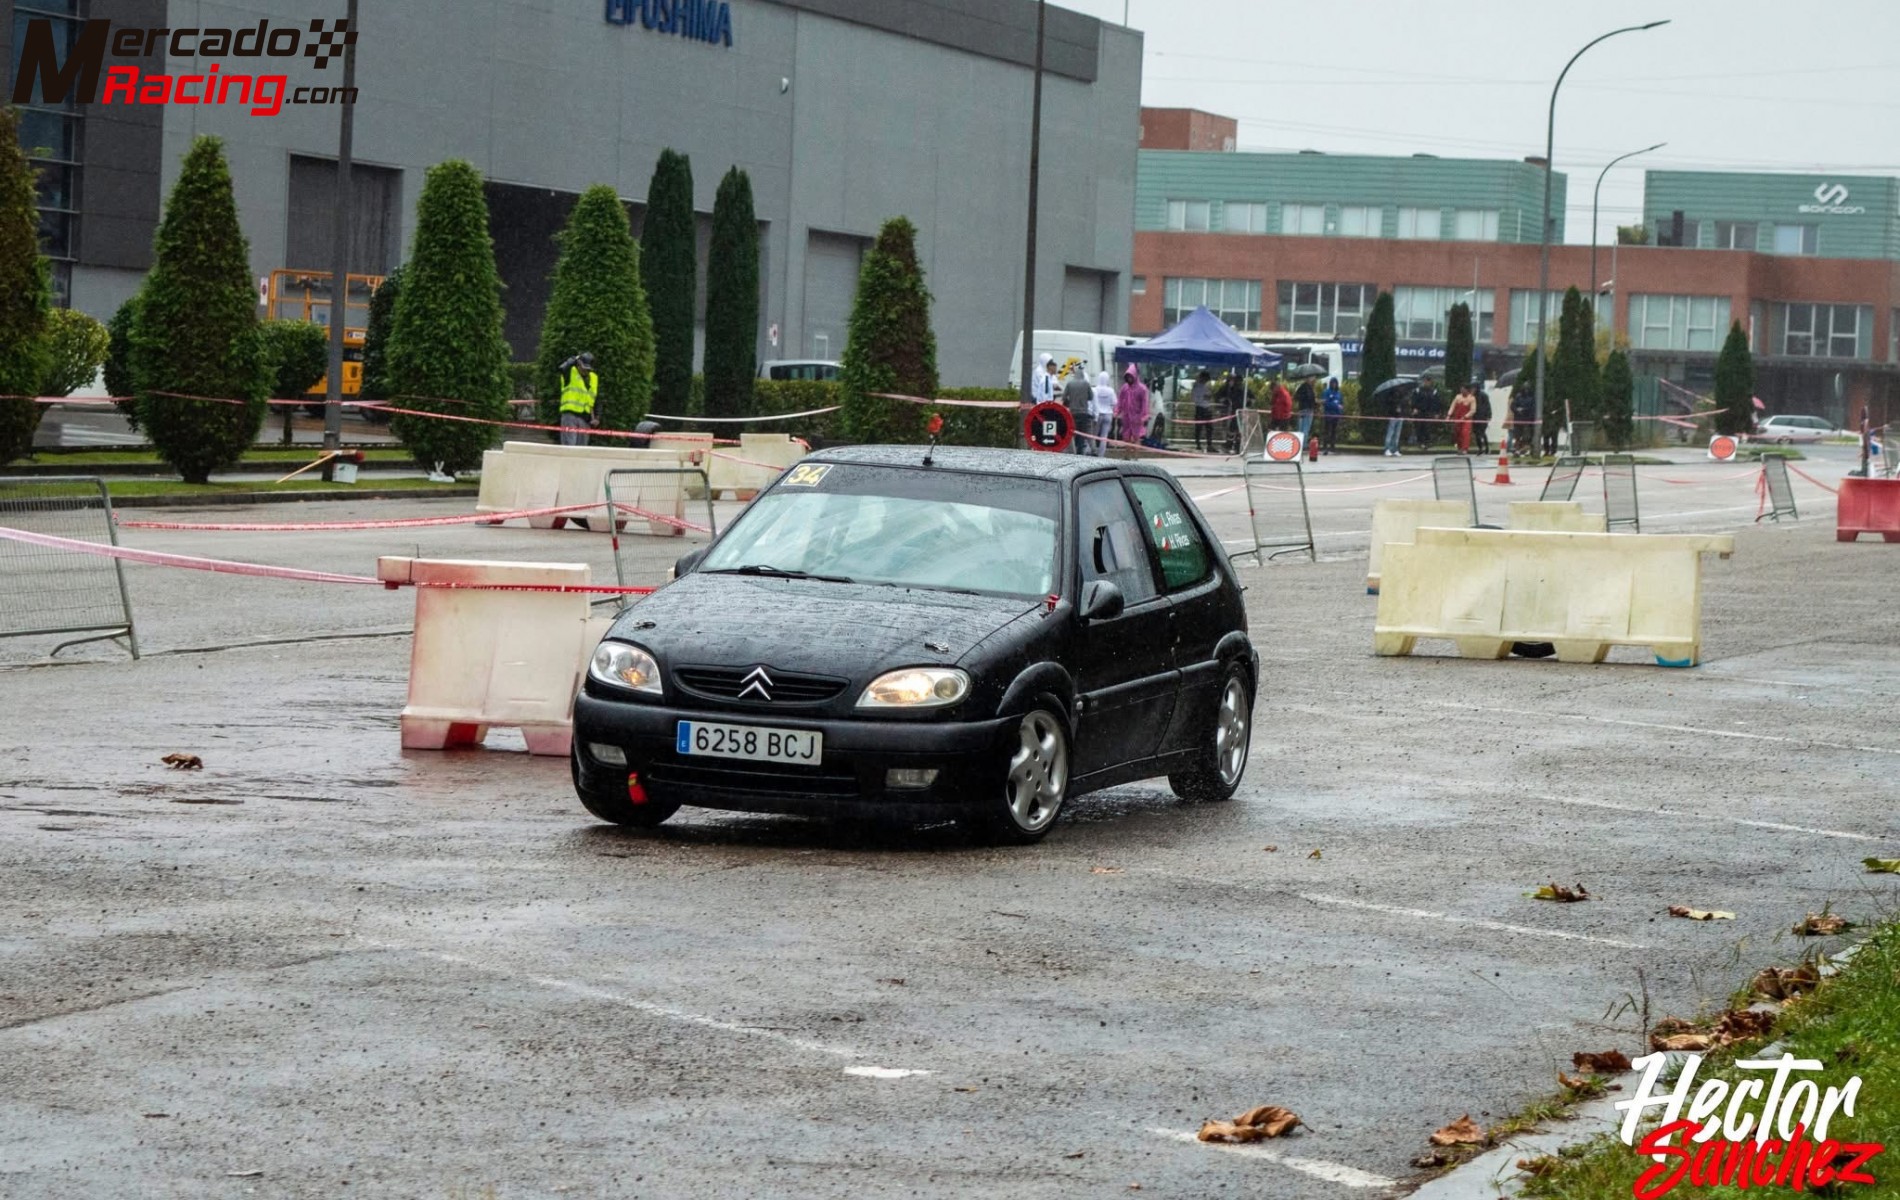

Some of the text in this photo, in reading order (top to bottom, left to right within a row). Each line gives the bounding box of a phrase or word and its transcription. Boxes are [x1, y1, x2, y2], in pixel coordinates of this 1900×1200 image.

[1046, 423, 1054, 433] P
[788, 465, 826, 485] 34
[696, 727, 758, 754] 6258
[767, 732, 815, 759] BCJ
